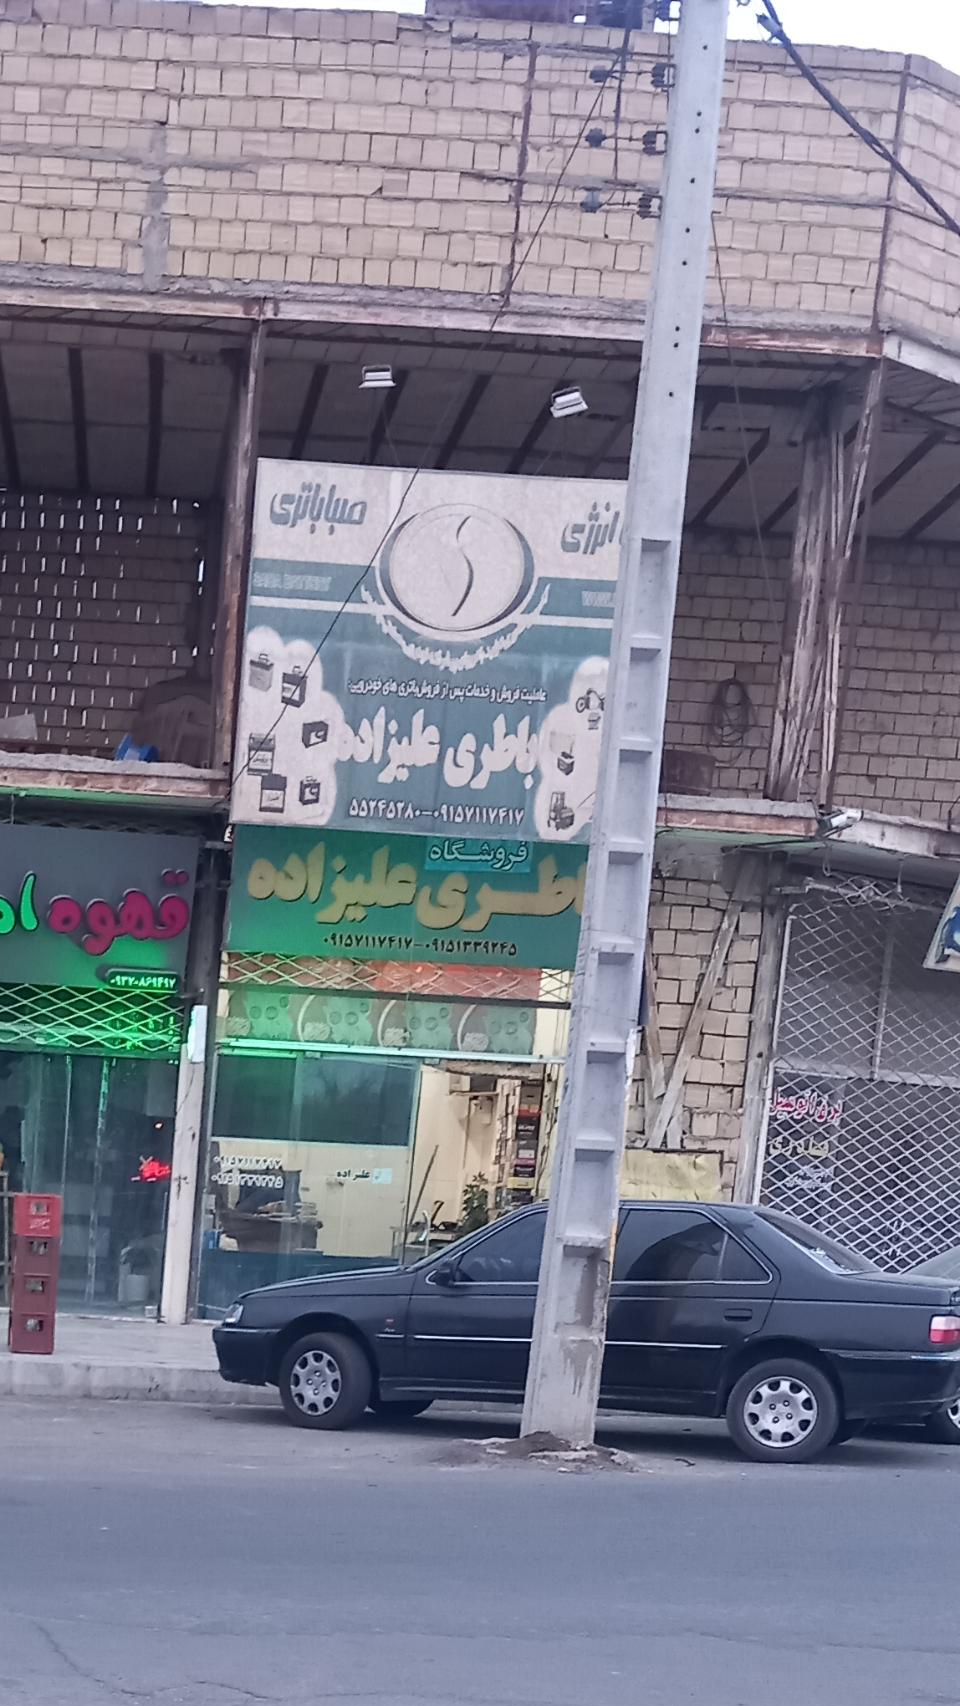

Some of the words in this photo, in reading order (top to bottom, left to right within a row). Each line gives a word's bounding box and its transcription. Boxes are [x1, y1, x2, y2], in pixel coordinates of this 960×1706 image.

[449, 686, 465, 703] پس
[465, 683, 490, 698] خدمات
[497, 685, 520, 704] فروش
[336, 706, 440, 784] علیزاده
[443, 713, 538, 790] باطری
[247, 841, 417, 924] علیزاده
[416, 854, 587, 932] اطری
[429, 839, 529, 872] فروشگاه
[47, 868, 191, 956] قهوه
